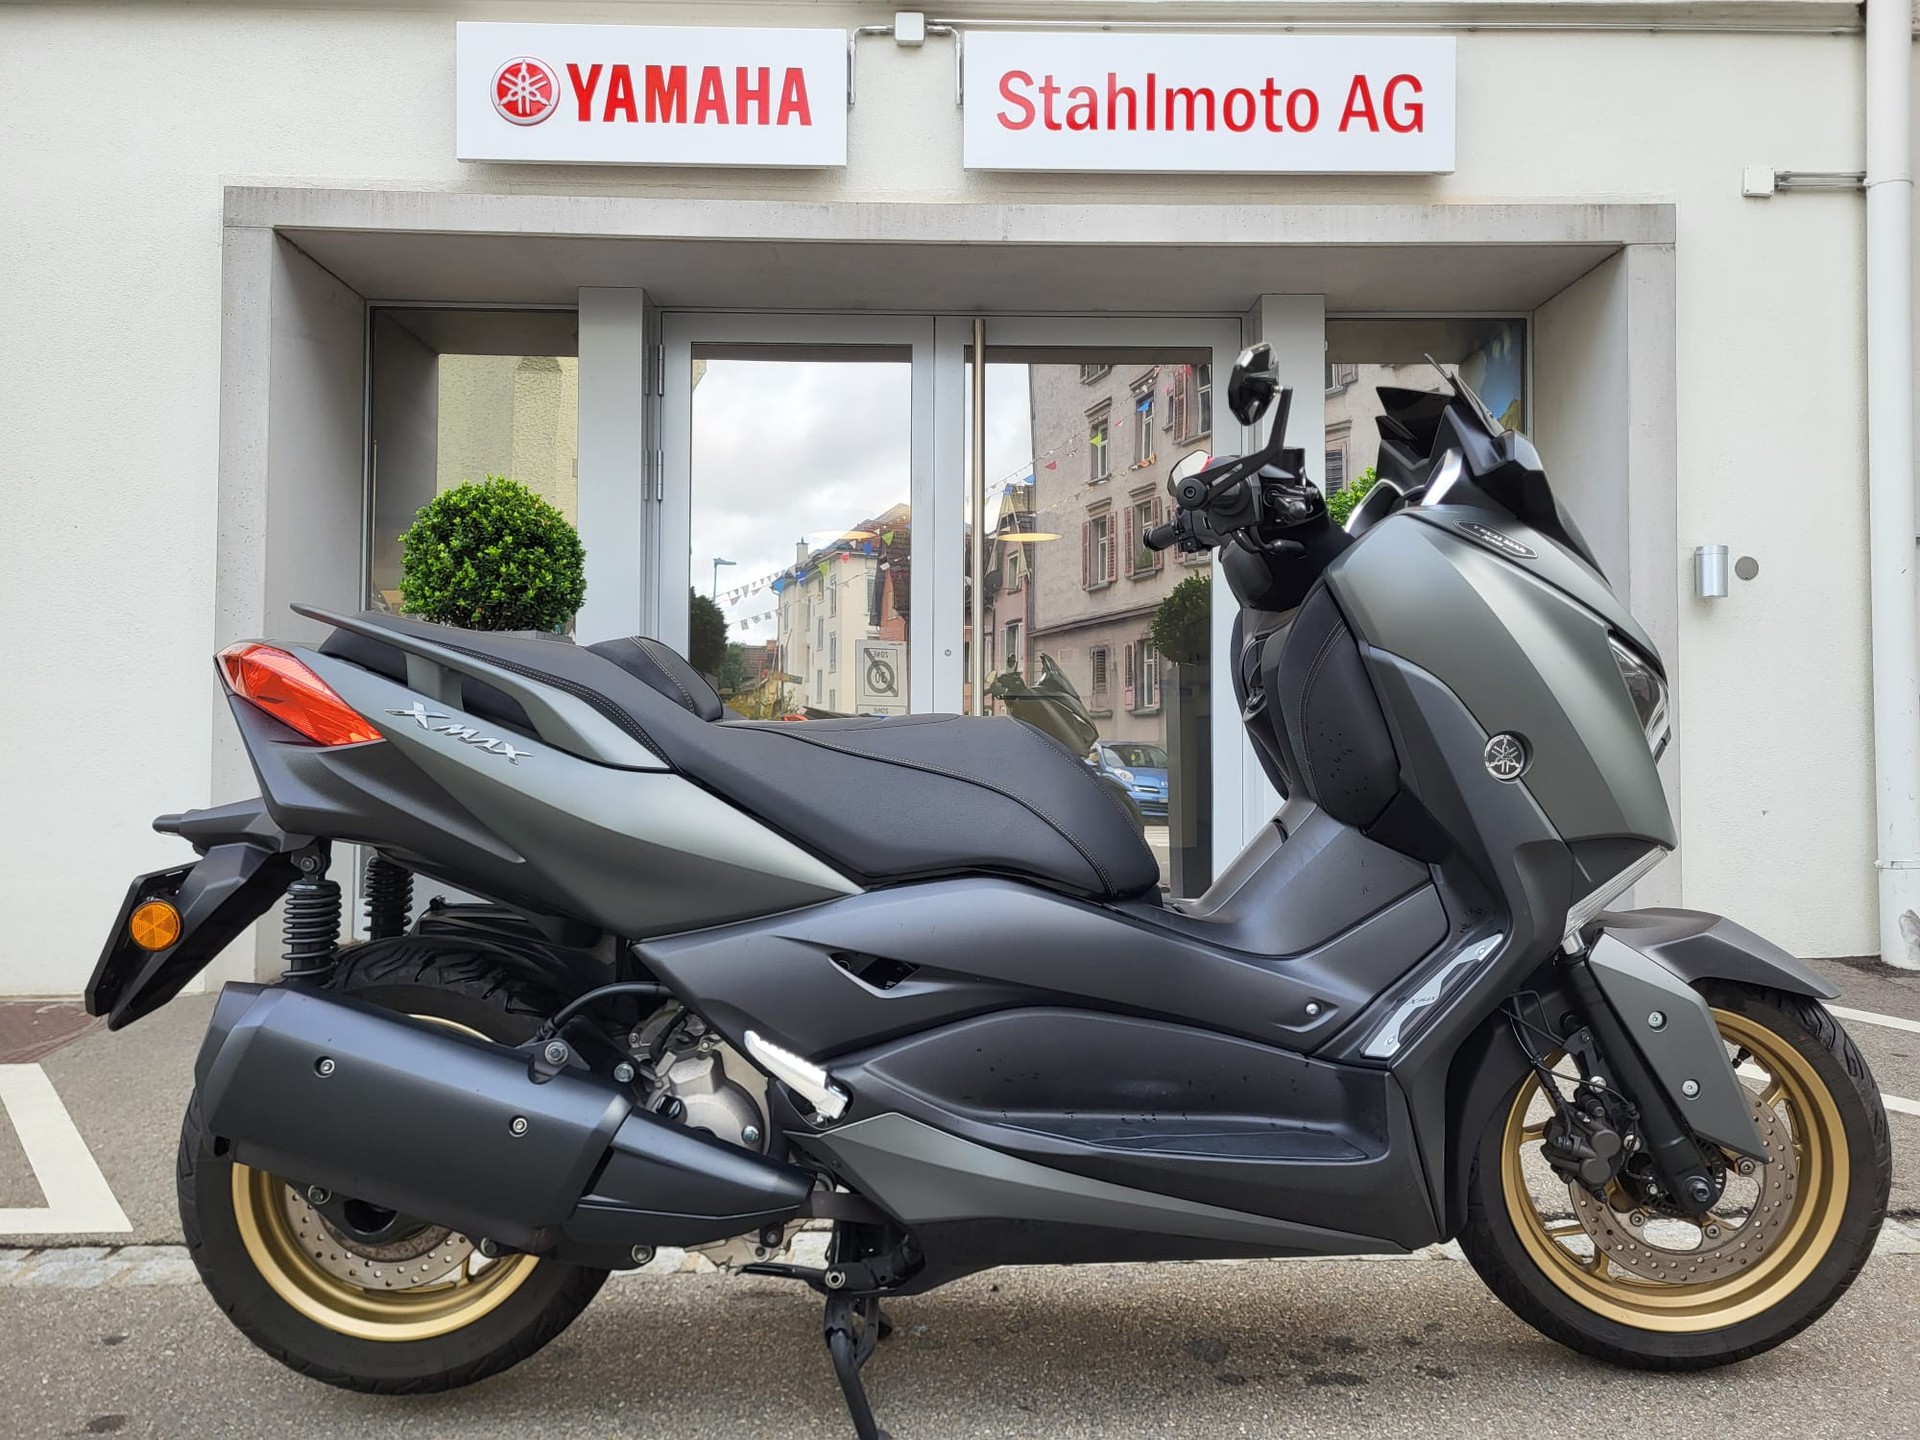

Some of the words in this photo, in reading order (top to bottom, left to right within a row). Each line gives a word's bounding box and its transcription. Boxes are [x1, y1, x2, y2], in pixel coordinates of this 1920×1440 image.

[566, 63, 812, 126] YAMAHA
[997, 70, 1319, 133] Stahlmoto
[1338, 73, 1424, 133] AG
[384, 701, 535, 766] XMAX
